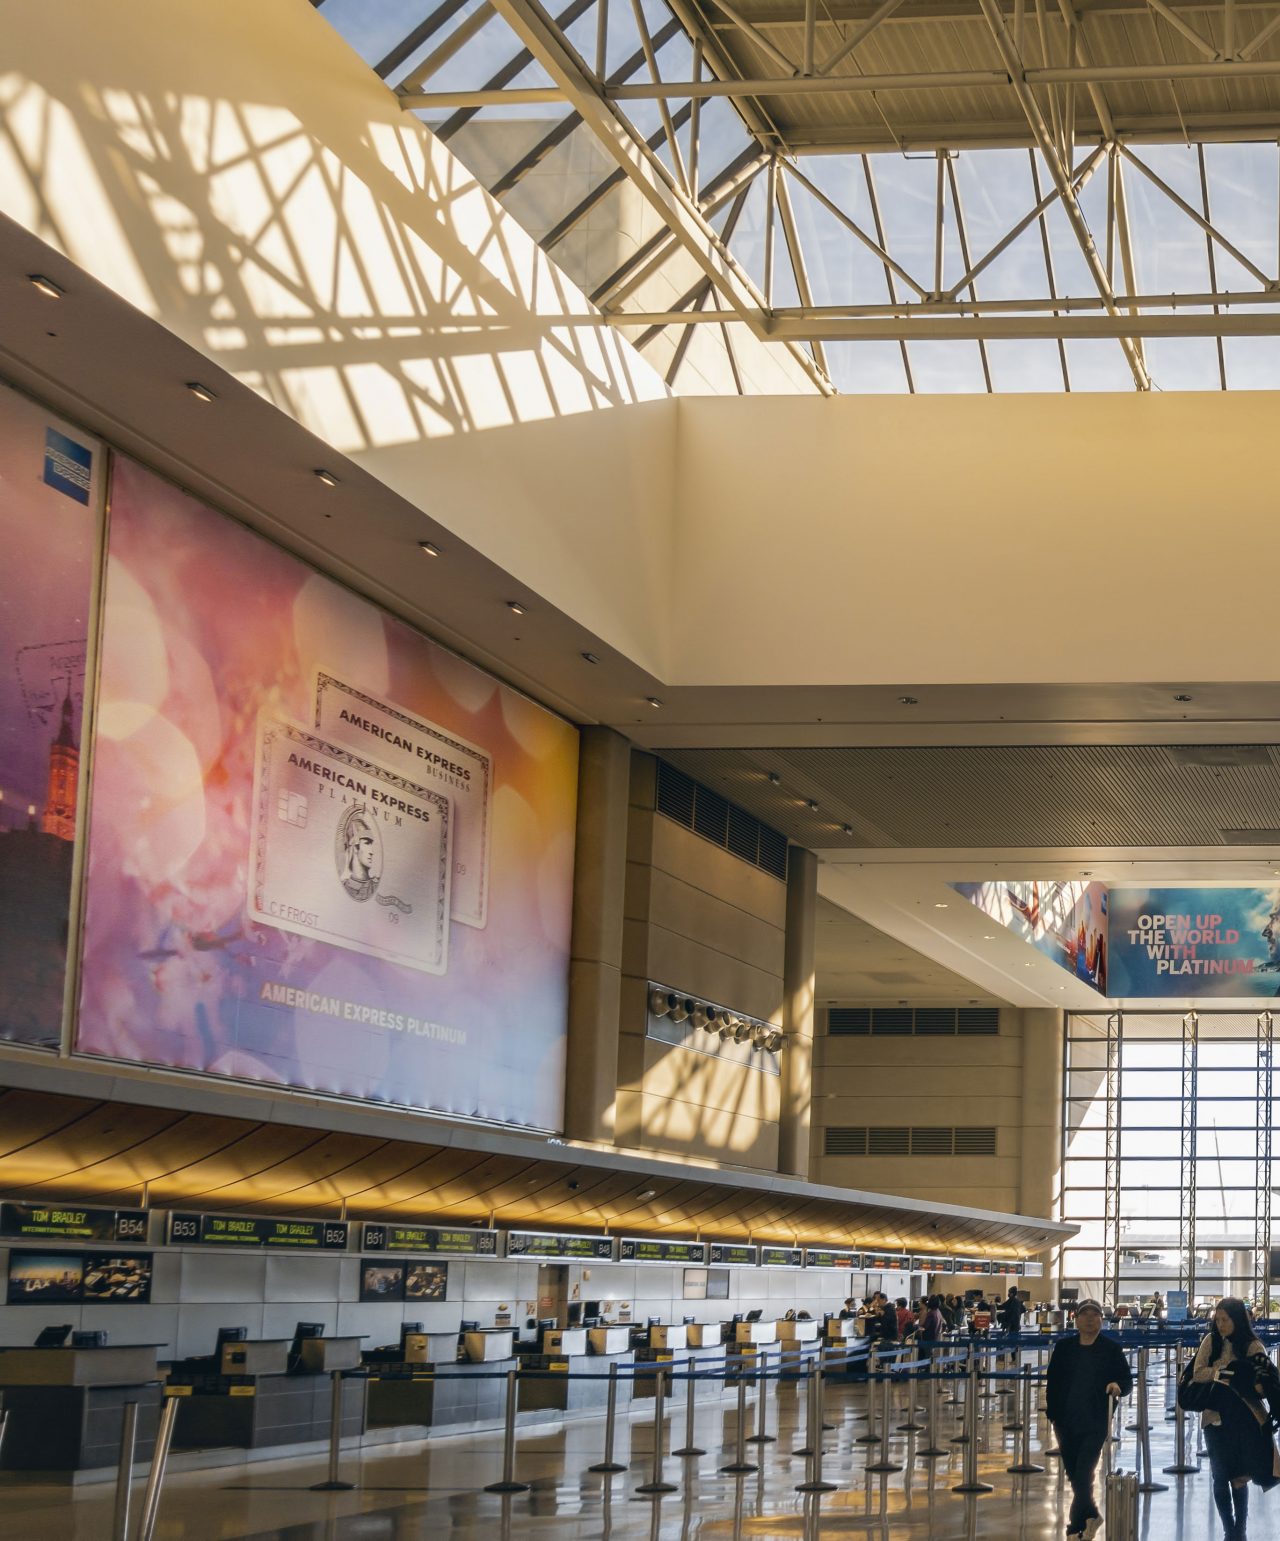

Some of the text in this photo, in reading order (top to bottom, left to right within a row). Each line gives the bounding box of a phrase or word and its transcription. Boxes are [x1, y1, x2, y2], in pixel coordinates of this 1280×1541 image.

[339, 709, 471, 781] AMERICAN EXPRESS
[426, 765, 471, 793] BUSINESS
[287, 752, 430, 823] AMERICAN EXPRESS
[318, 783, 403, 827] PLATINUM
[270, 901, 320, 928] C F FROST
[1137, 914, 1222, 930] OPEN UP
[1127, 929, 1240, 945] THE WORLD
[1146, 944, 1196, 960] WITH
[1157, 959, 1255, 975] PLATINUM
[261, 982, 467, 1045] AMERICAN EXPRESS PLATINUM
[32, 1210, 87, 1224] TOM BRADLEY
[119, 1219, 143, 1234] B54
[173, 1221, 197, 1236] B53
[213, 1220, 225, 1231] TOM
[326, 1230, 345, 1243] B52
[366, 1232, 384, 1244] B51
[480, 1238, 494, 1249] B50
[25, 1279, 50, 1292] LAX
